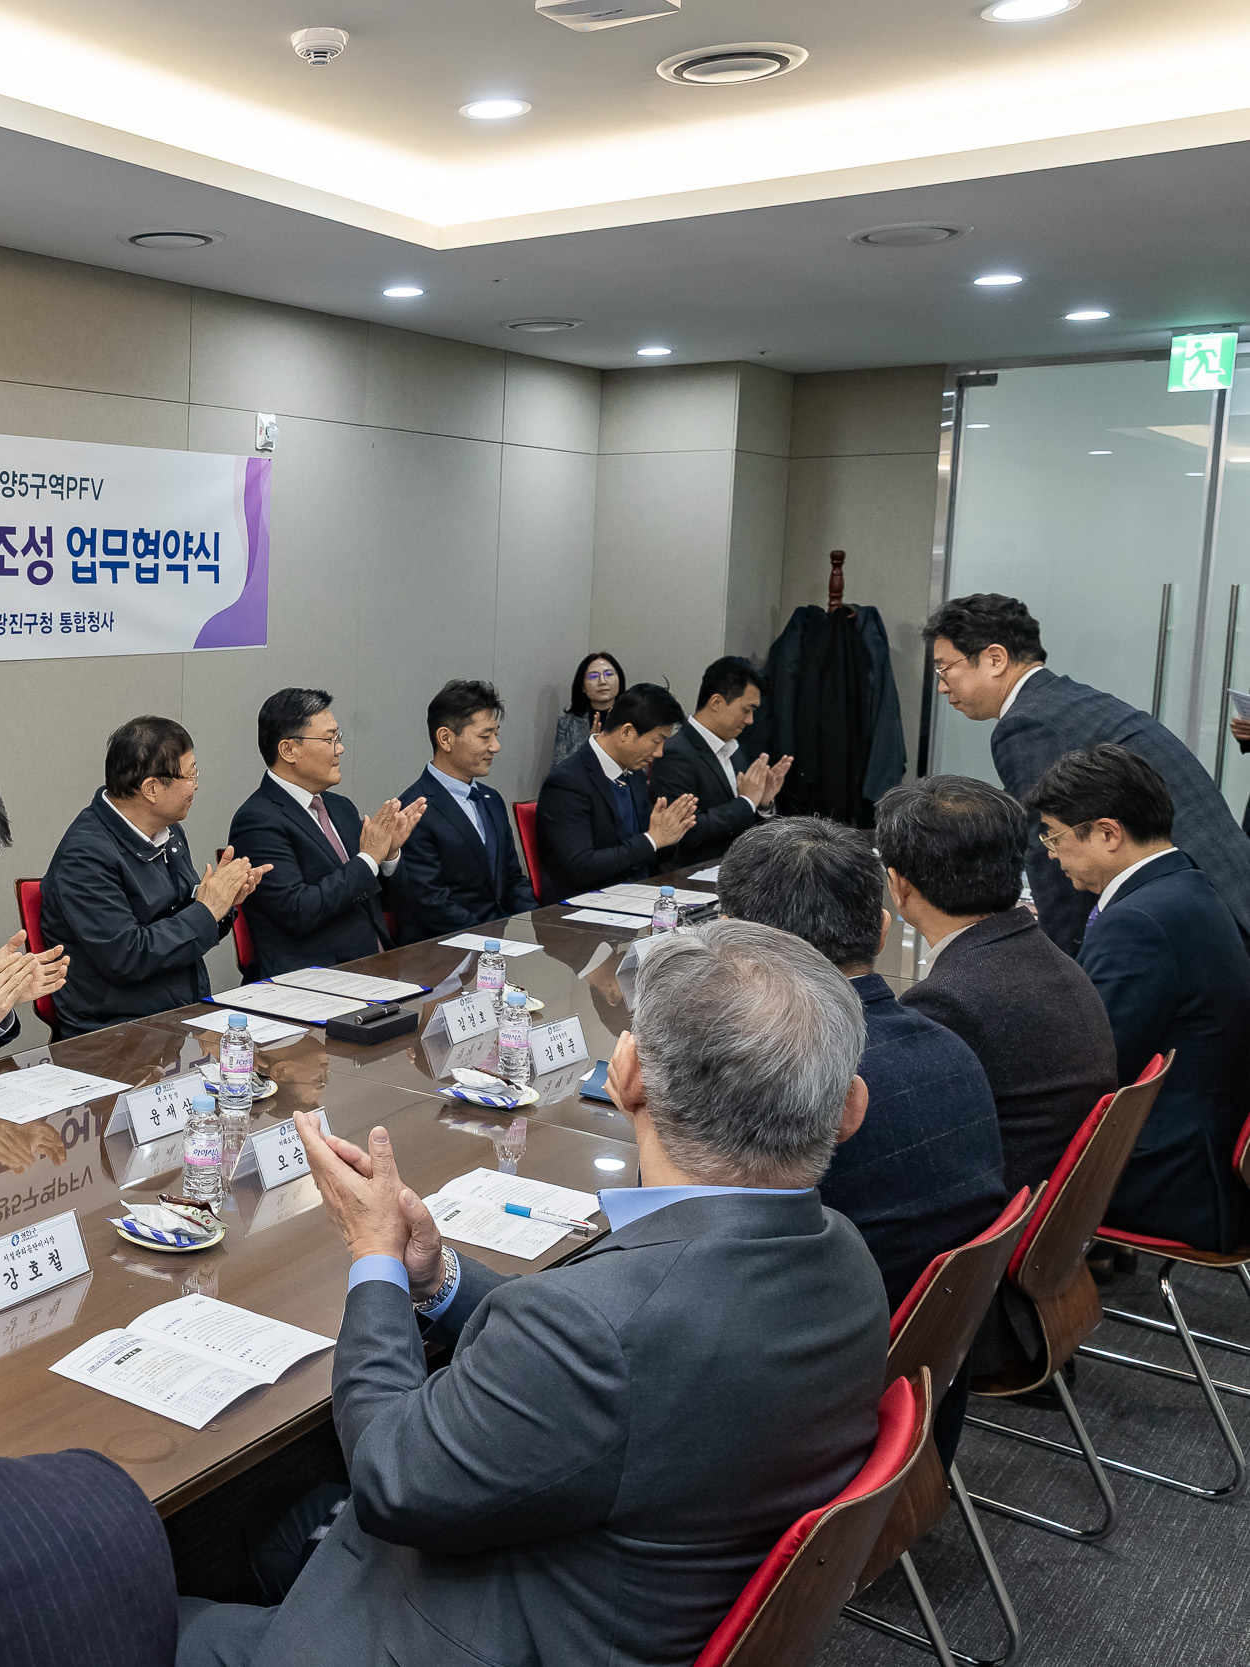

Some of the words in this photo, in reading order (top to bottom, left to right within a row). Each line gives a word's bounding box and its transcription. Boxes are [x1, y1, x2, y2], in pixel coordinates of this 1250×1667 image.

[66, 525, 220, 585] 업무협약식
[59, 610, 115, 634] 통합청사
[278, 1146, 304, 1171] 오승
